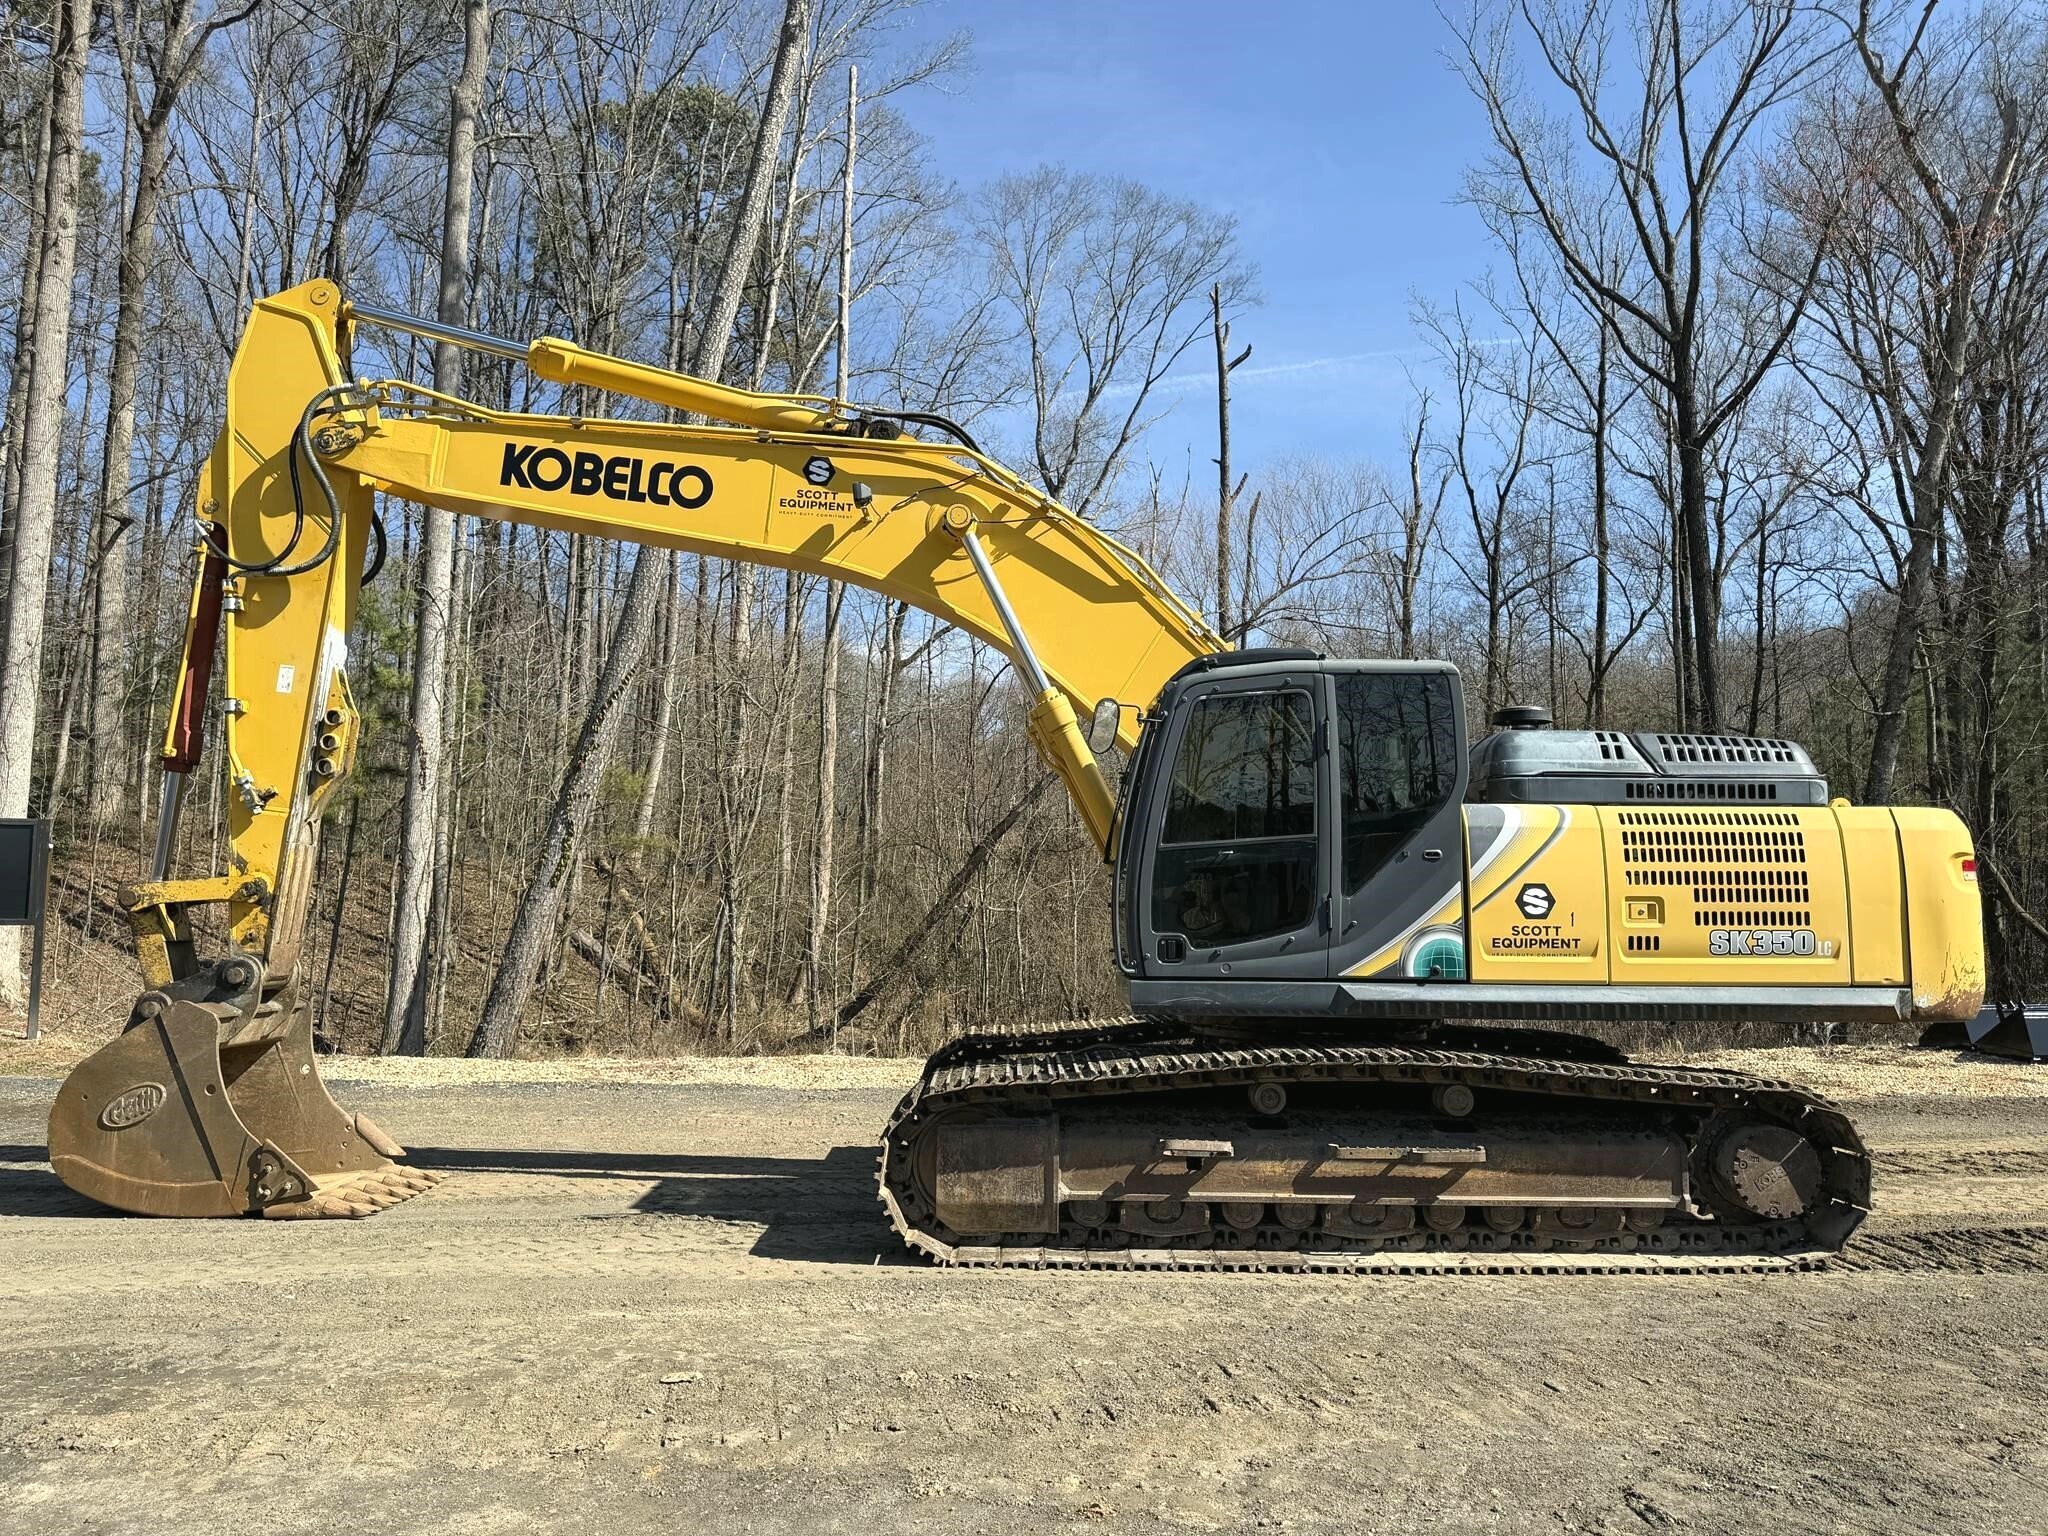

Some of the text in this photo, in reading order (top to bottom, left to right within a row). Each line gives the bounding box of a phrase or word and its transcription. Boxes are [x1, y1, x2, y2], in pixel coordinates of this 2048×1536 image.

[500, 443, 714, 510] KOBELCO
[796, 489, 838, 500] SCOTT
[780, 499, 853, 512] EQUIPMENT
[1511, 925, 1562, 937] SCOTT
[1492, 938, 1581, 949] EQUIPMENT
[1709, 929, 1832, 956] SK350 LC
